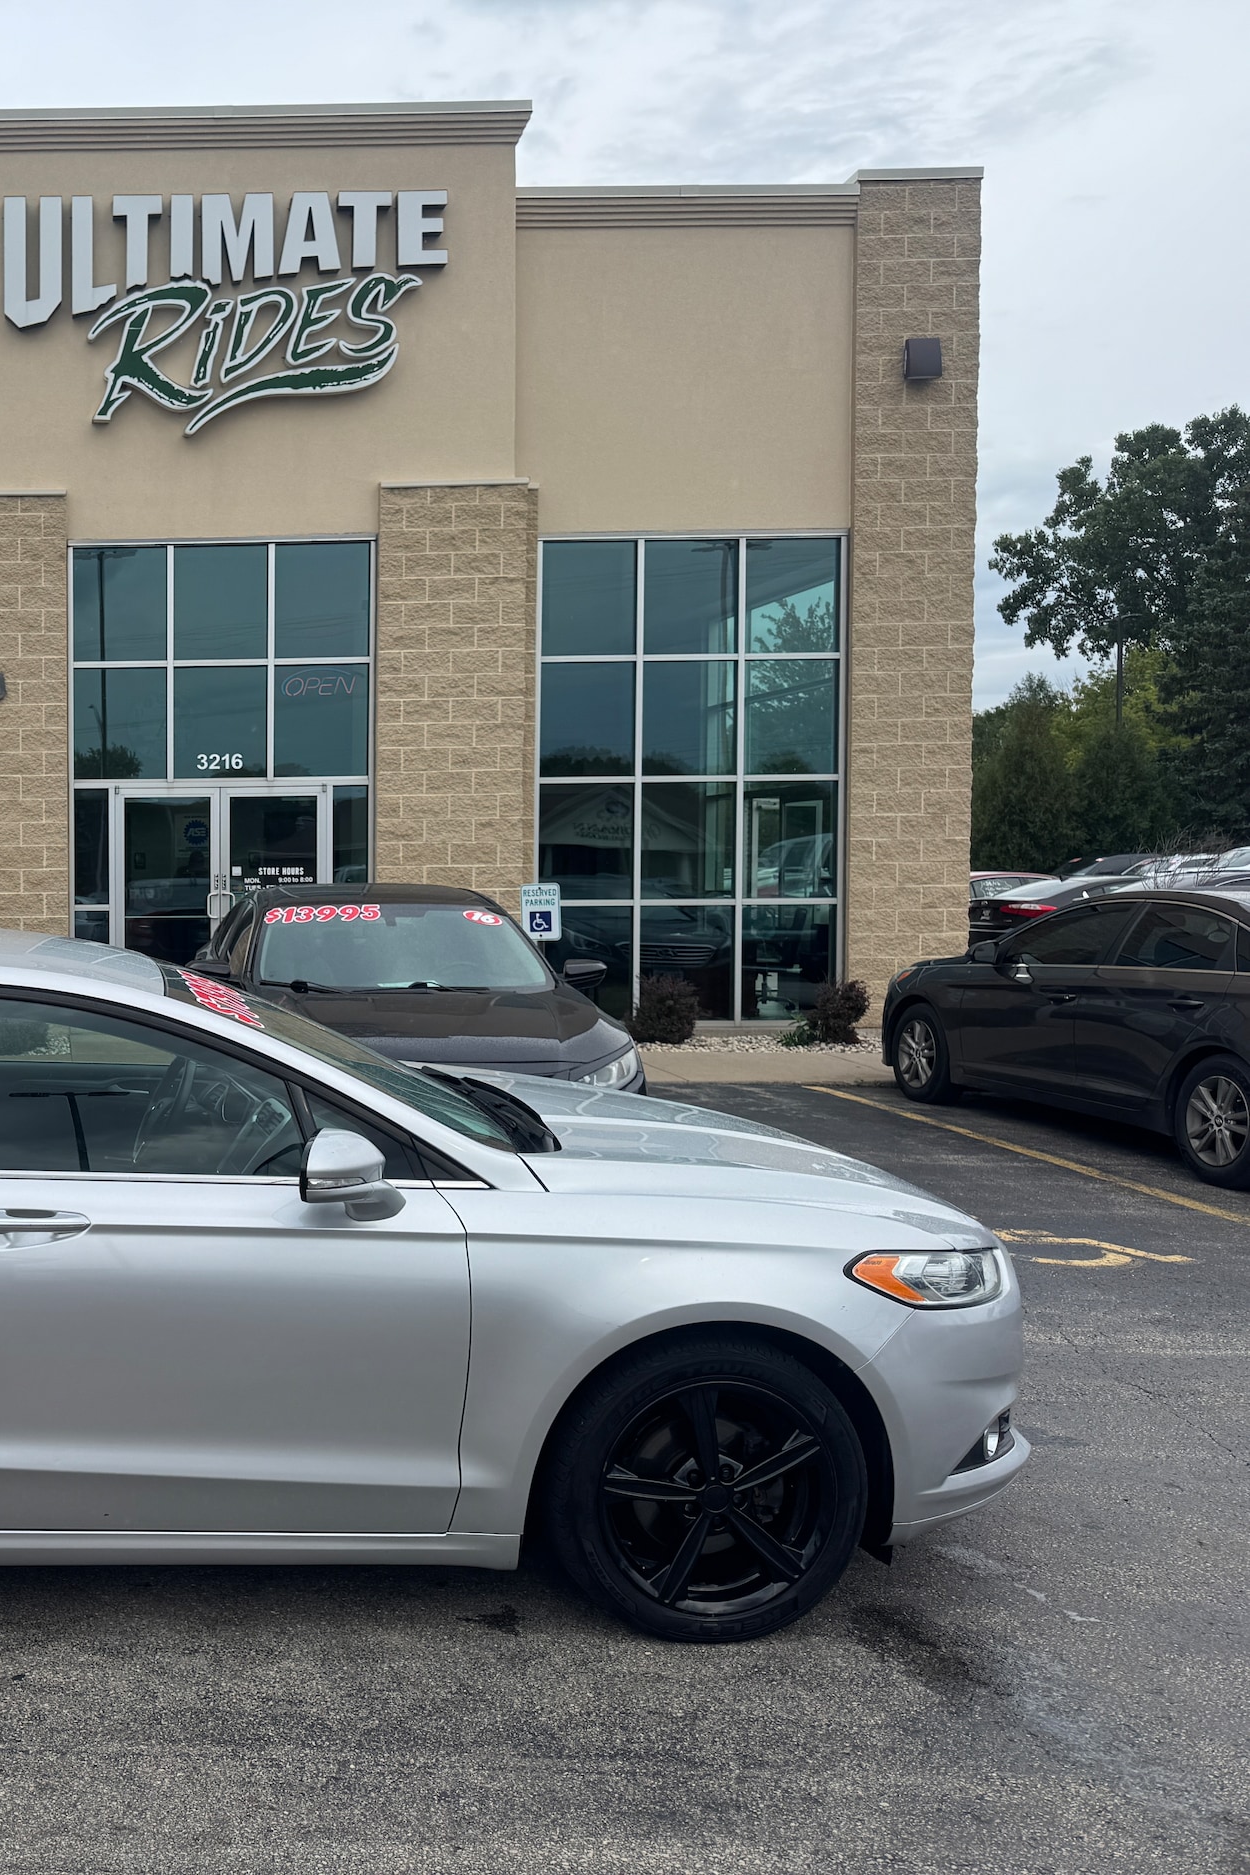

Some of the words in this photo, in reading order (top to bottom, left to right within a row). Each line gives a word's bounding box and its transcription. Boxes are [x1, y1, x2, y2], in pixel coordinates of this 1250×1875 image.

[3, 189, 449, 329] ULTIMATE
[284, 676, 356, 697] OPEN
[196, 753, 243, 770] 3216
[187, 827, 207, 837] ASE
[258, 867, 280, 875] STORE
[281, 867, 304, 875] HOURS
[522, 888, 557, 897] RESERVED
[525, 898, 555, 907] PARKING
[264, 904, 381, 924] $13995
